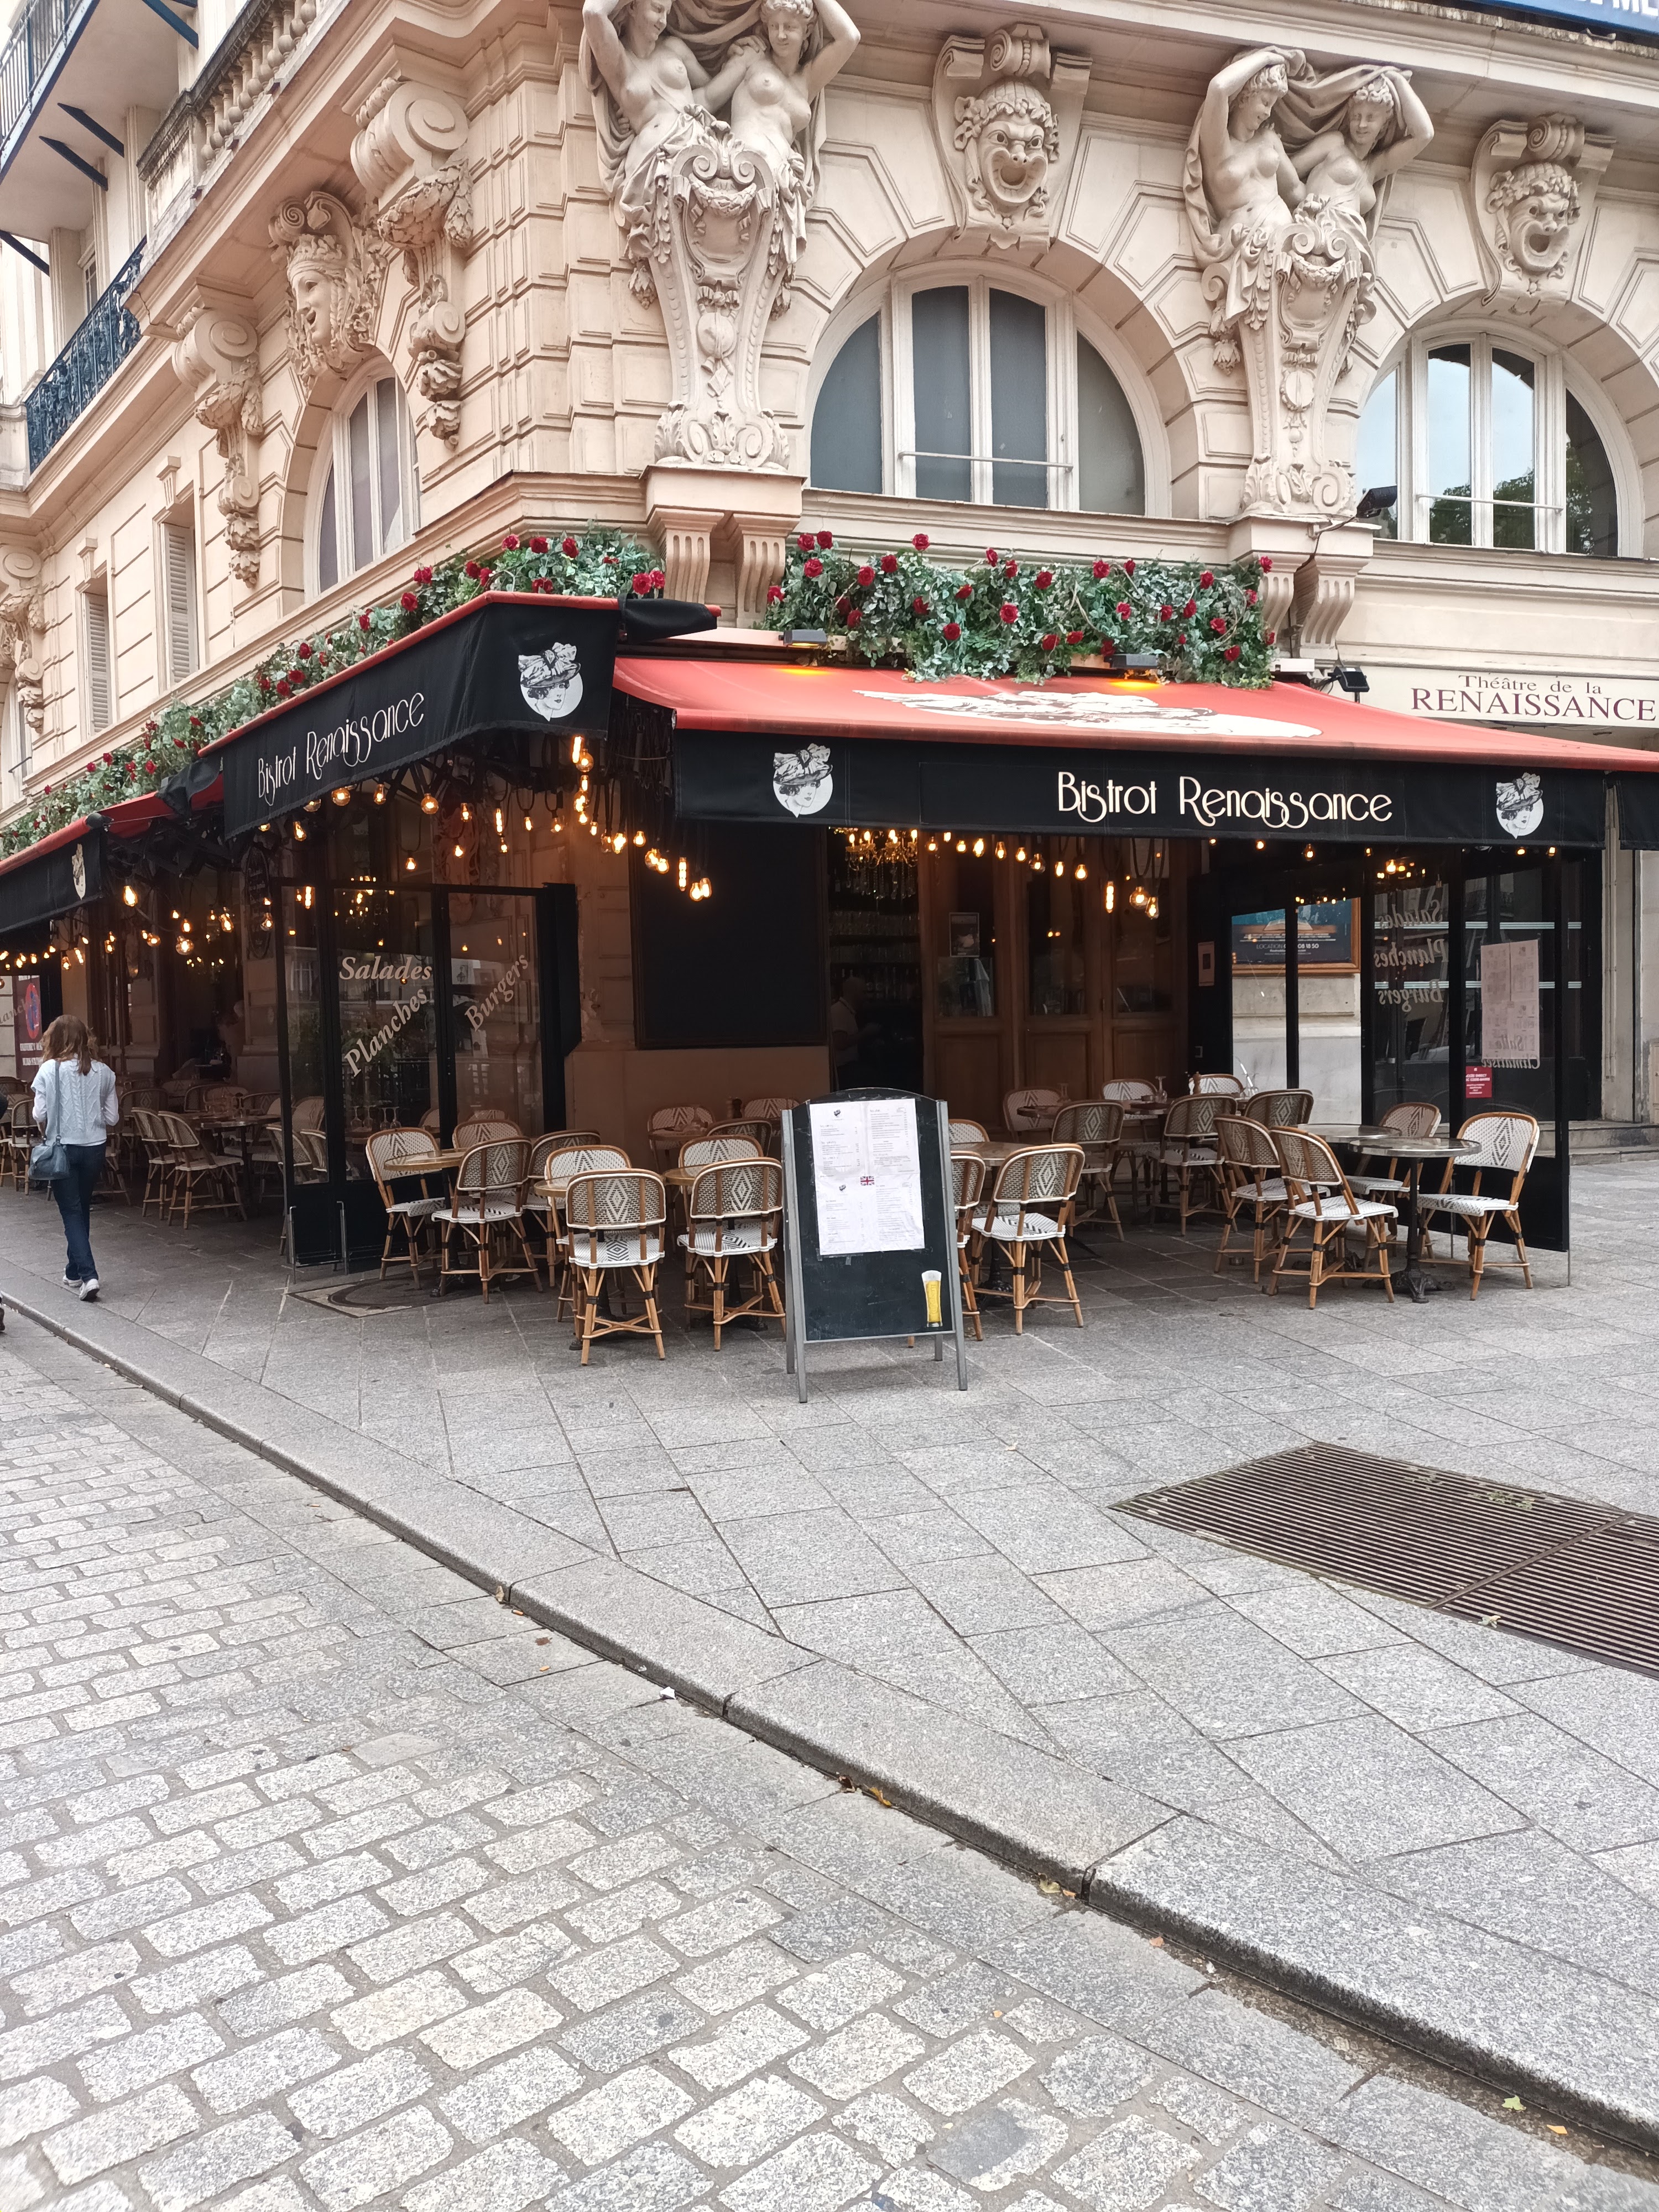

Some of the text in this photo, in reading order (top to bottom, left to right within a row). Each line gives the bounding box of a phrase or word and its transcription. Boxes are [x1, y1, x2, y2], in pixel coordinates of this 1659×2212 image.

[1411, 687, 1656, 721] RENAISSANCE
[1458, 674, 1602, 694] Théâtre de la
[258, 692, 425, 806] Bistrot Renaissance
[1057, 771, 1392, 828] Bistrot Renaissance
[339, 956, 432, 980] Salades
[464, 954, 529, 1032] Burgers
[344, 989, 427, 1078] Planches
